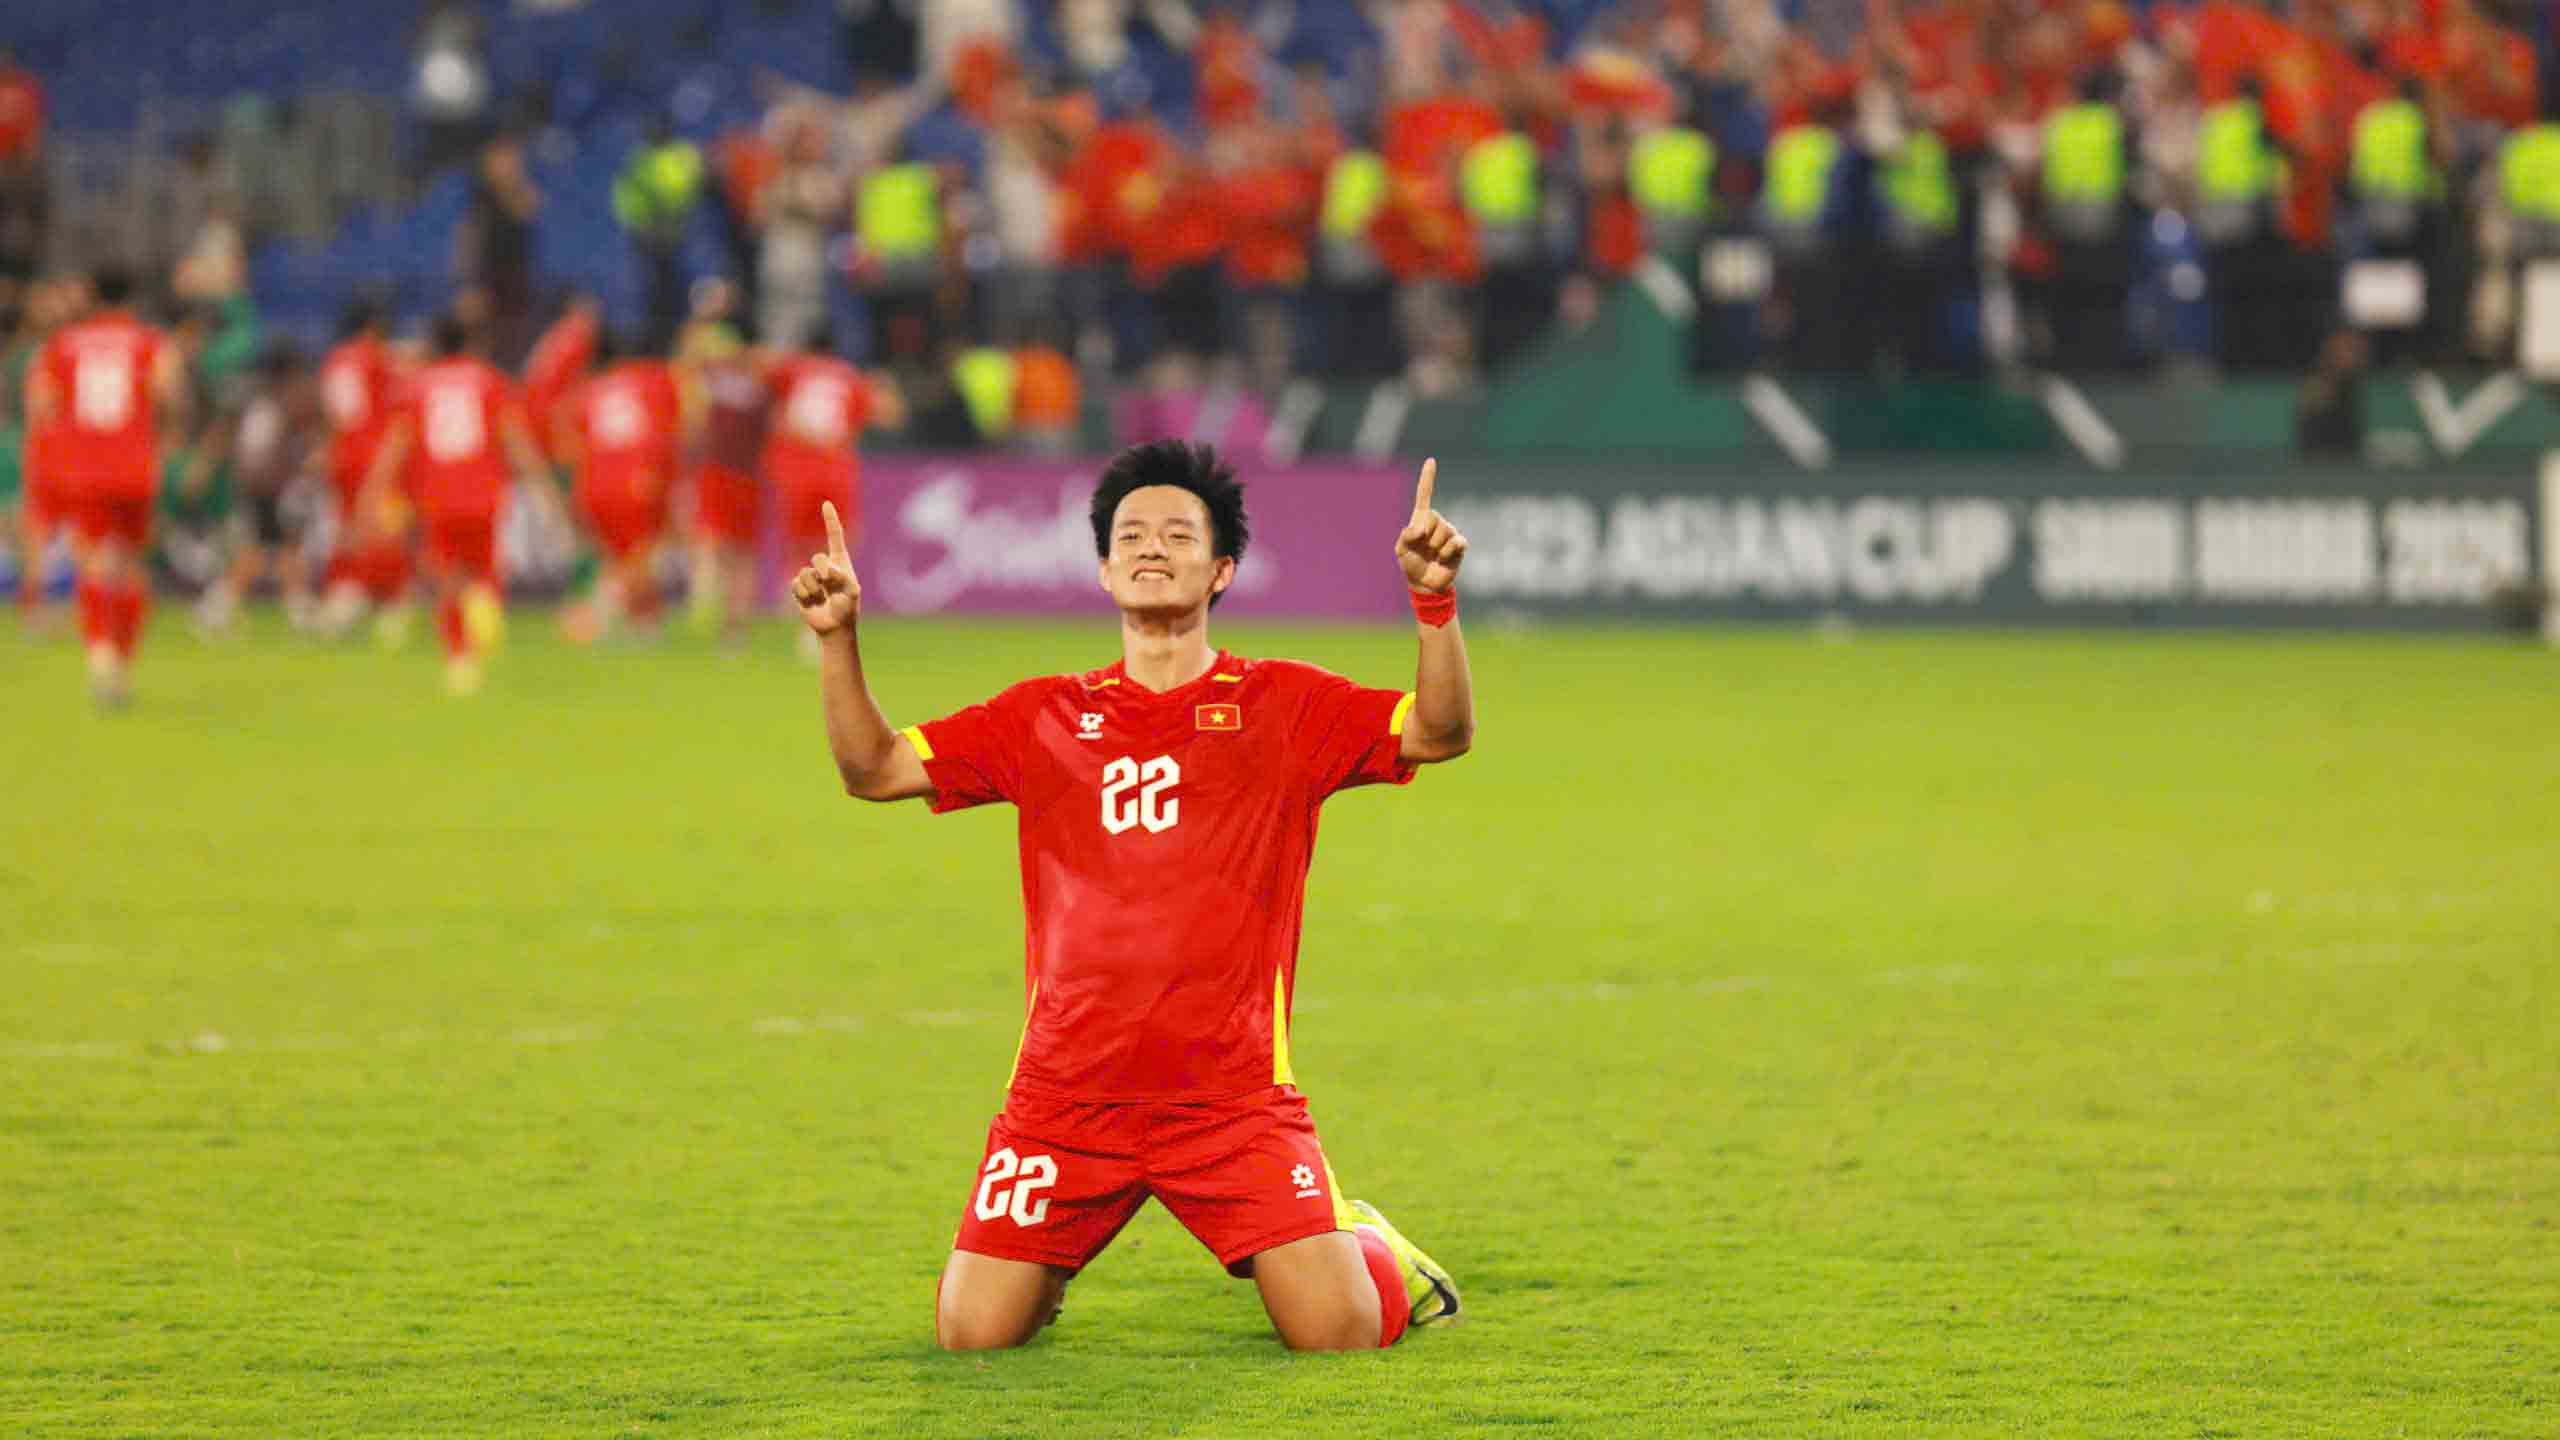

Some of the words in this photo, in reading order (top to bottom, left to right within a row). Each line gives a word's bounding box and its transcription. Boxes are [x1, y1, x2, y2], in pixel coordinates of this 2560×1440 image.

[1846, 497, 2013, 604] CUP
[1101, 756, 1180, 834] 22
[975, 1147, 1058, 1228] 22
